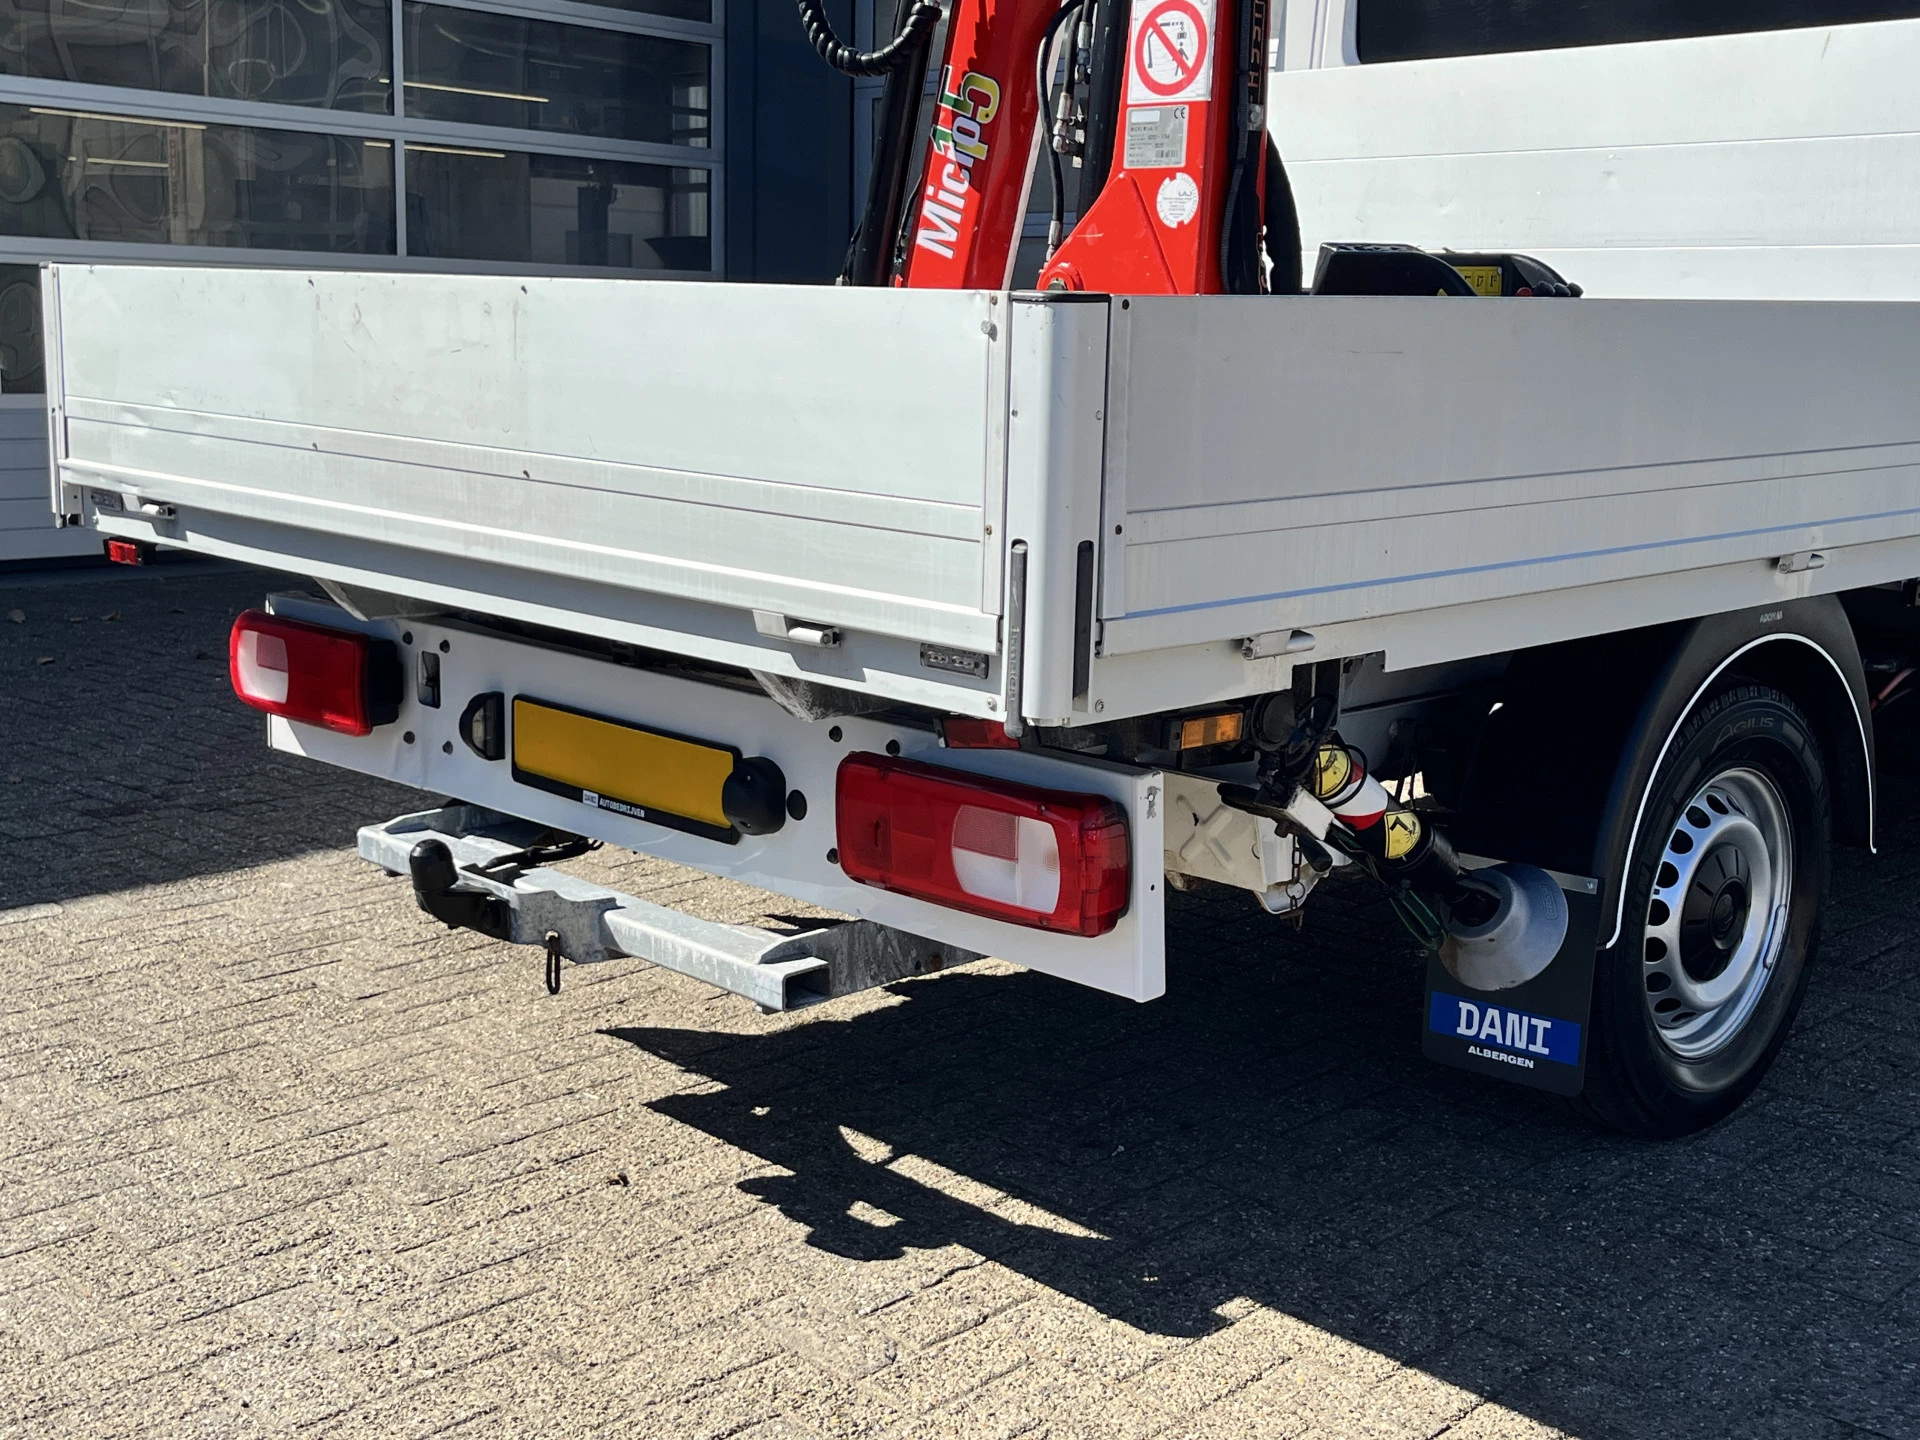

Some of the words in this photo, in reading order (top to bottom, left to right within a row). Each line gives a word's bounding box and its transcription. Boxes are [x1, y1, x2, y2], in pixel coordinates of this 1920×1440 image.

[916, 116, 982, 259] Micro
[1457, 1001, 1552, 1055] DANI
[1467, 1045, 1534, 1069] ALBERGEN
